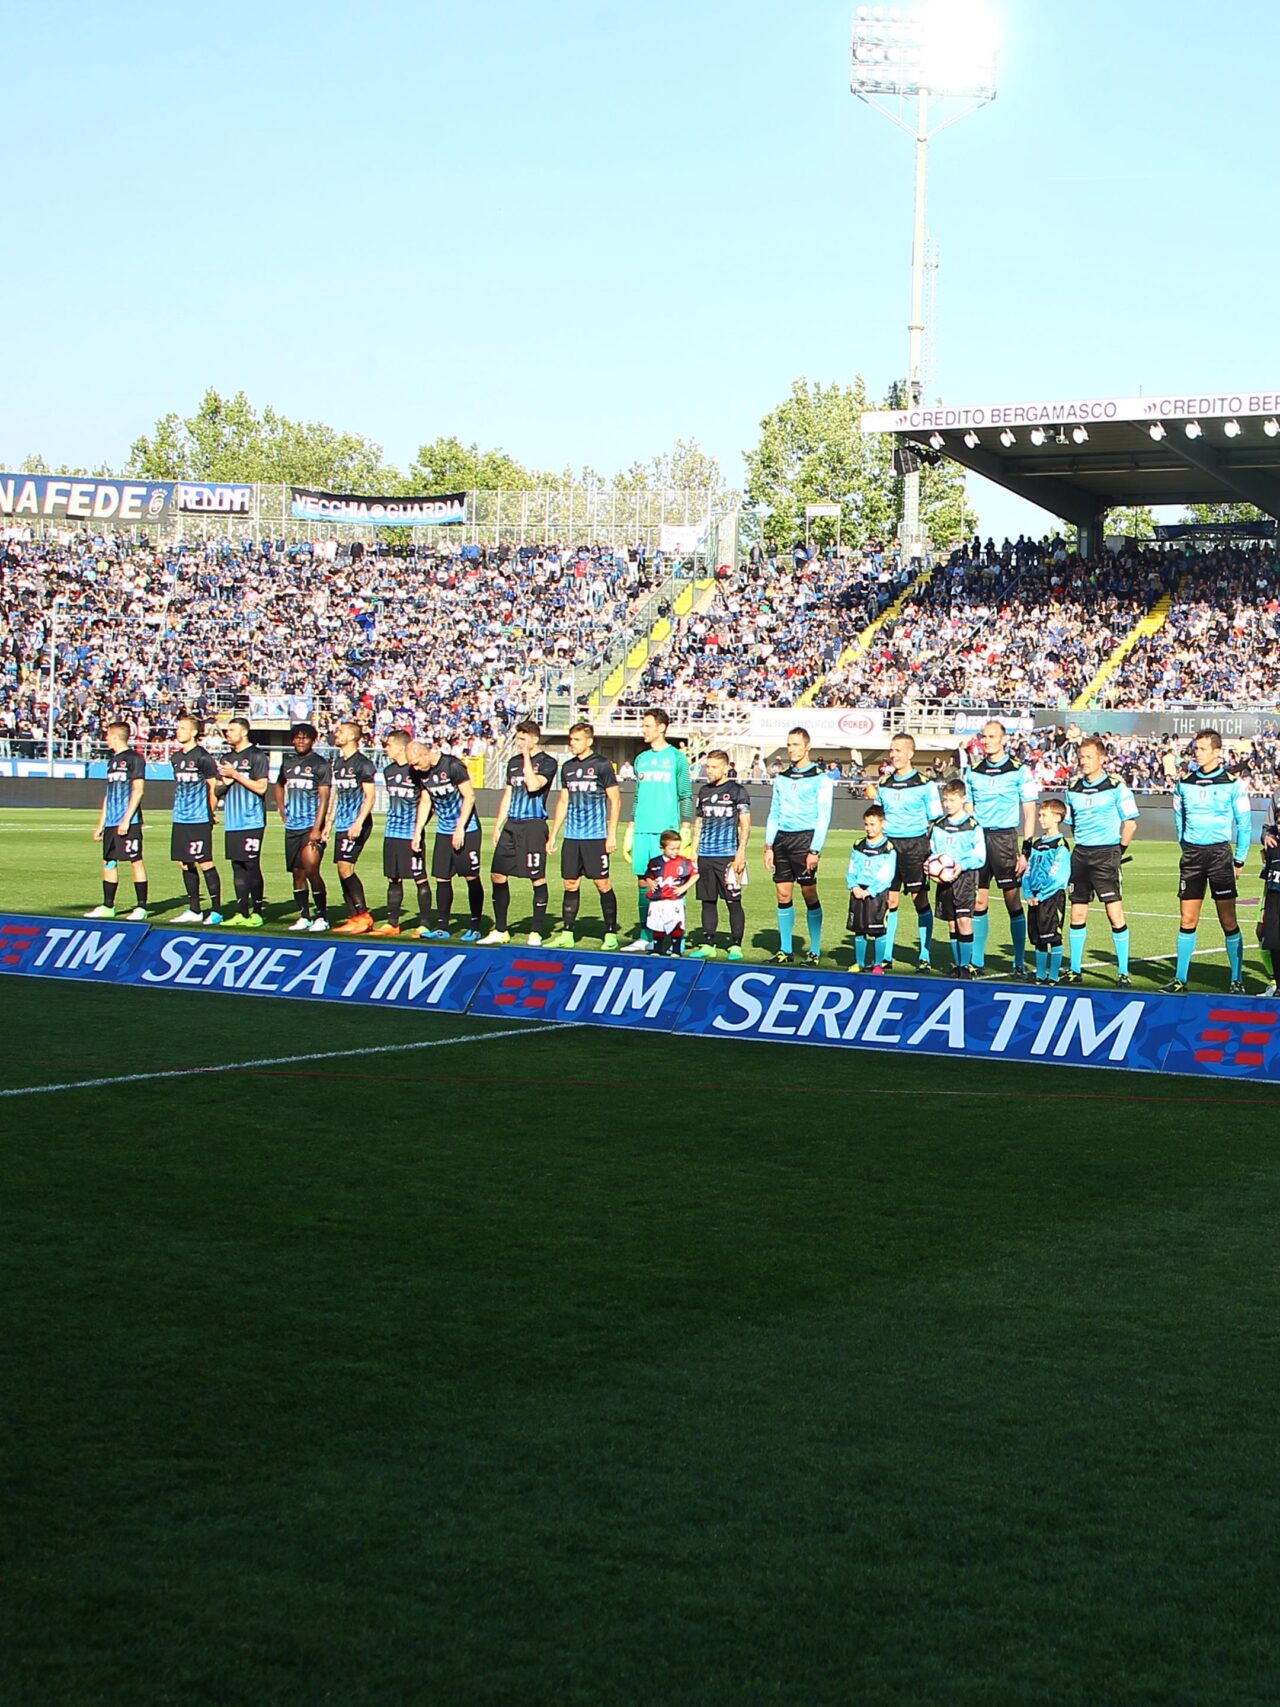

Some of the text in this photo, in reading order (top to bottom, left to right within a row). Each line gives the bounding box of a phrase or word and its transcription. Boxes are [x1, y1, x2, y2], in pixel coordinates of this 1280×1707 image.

[909, 402, 1118, 429] CREDITO BERGAMASCO
[1159, 397, 1242, 417] CREDITO
[43, 481, 147, 520] FEDE
[295, 493, 462, 520] VECCHIA GUARDIA
[842, 720, 869, 729] POKER
[1173, 718, 1242, 734] THE MATCH
[704, 805, 733, 818] TWS
[125, 839, 139, 853] 24
[189, 841, 204, 855] 27
[244, 838, 260, 852] 29
[470, 850, 479, 865] 5
[527, 853, 541, 868] 13
[34, 928, 126, 971] TIM
[142, 936, 467, 1004] SERIE A TIM
[566, 964, 676, 1018] TIM
[712, 972, 1145, 1061] SERIE A TIM
